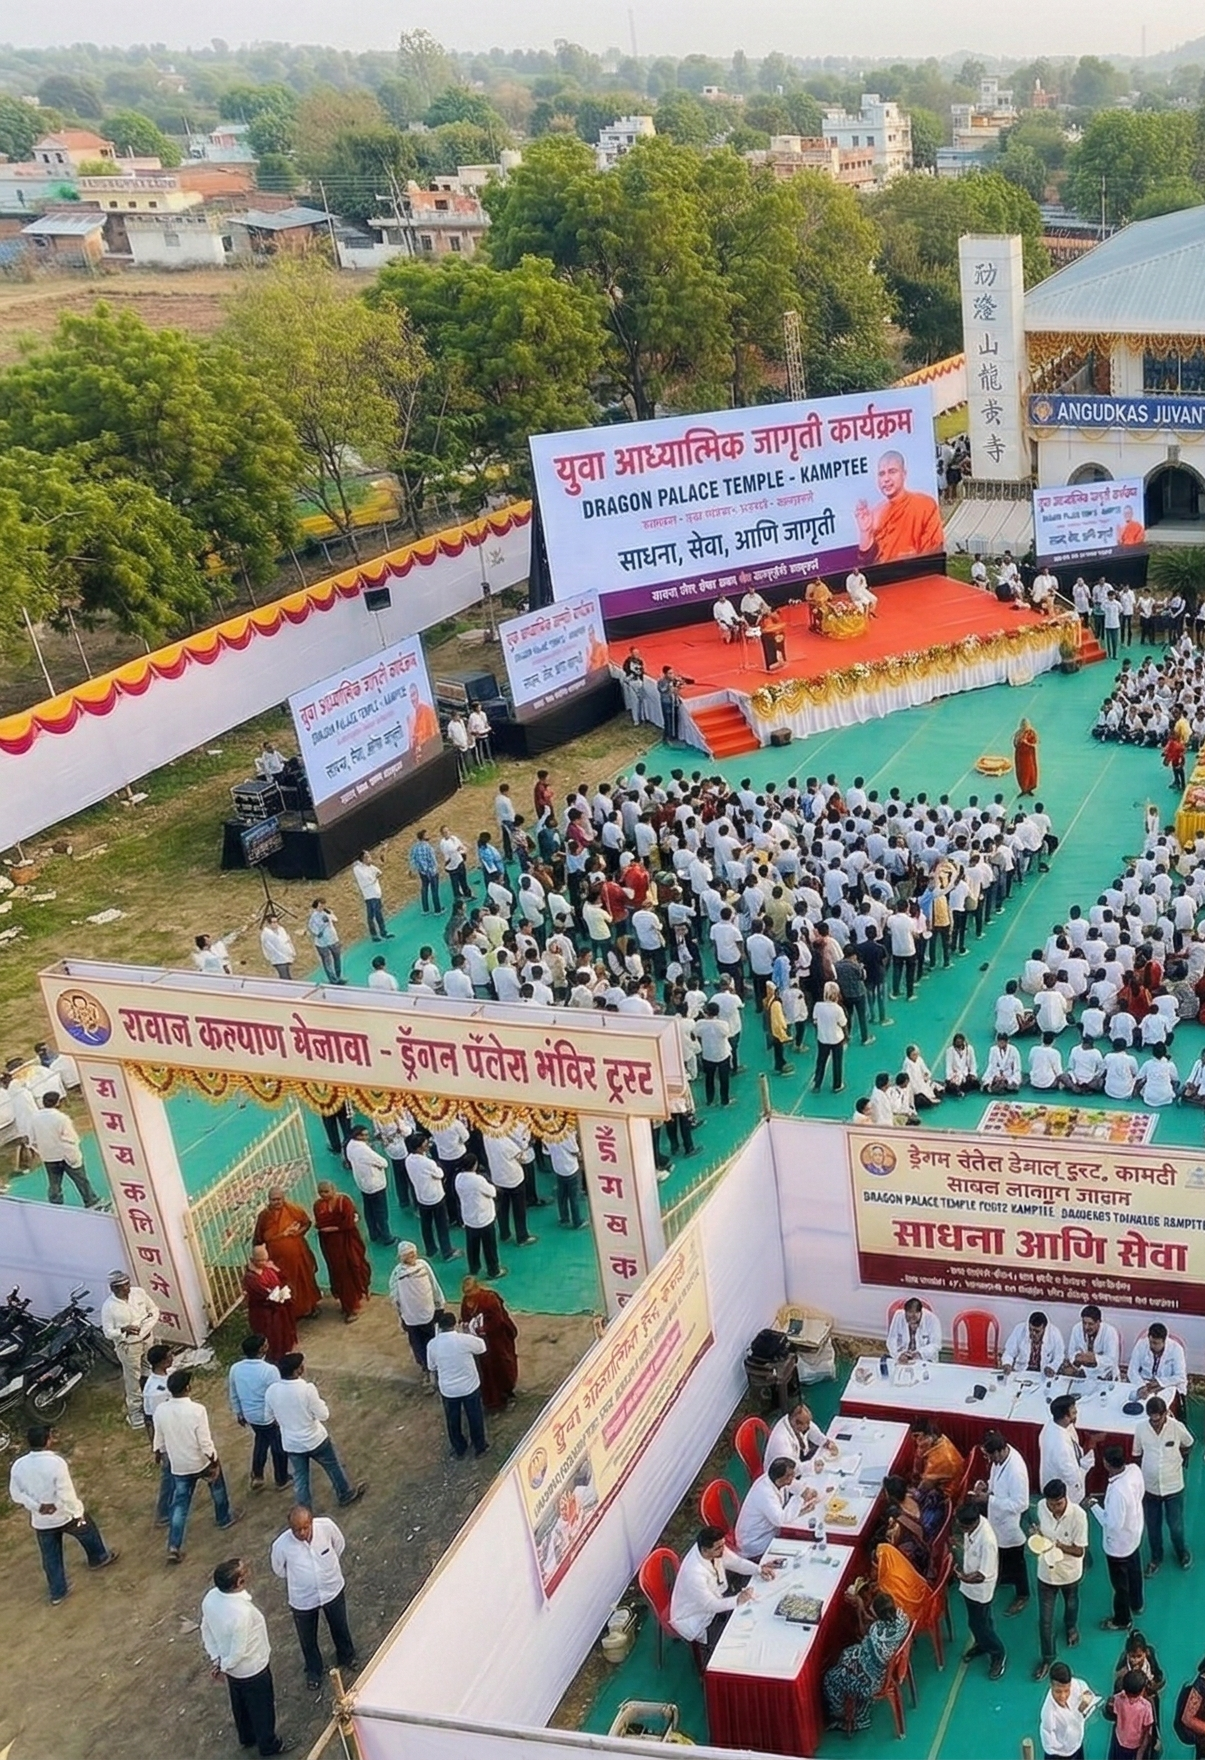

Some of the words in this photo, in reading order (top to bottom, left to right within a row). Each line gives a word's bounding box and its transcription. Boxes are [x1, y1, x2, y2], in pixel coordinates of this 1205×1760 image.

[1057, 402, 1148, 423] ANGUDKAS
[553, 451, 605, 497] युवा
[614, 427, 745, 476] आध्यात्मिक
[751, 412, 823, 462] जागृती
[828, 403, 913, 444] कार्यक्रम
[583, 489, 652, 519] DRAGON
[658, 480, 720, 507] PALACE
[723, 470, 785, 497] TEMPLE
[800, 456, 869, 484] KAMPTEE
[618, 542, 683, 572] साधना,
[687, 530, 729, 560] सेवा,
[735, 519, 779, 551] आणि
[783, 507, 836, 545] जागृती
[892, 1219, 1005, 1256] साधना
[1016, 1226, 1108, 1265] आणि
[1116, 1230, 1188, 1272] सेवा
